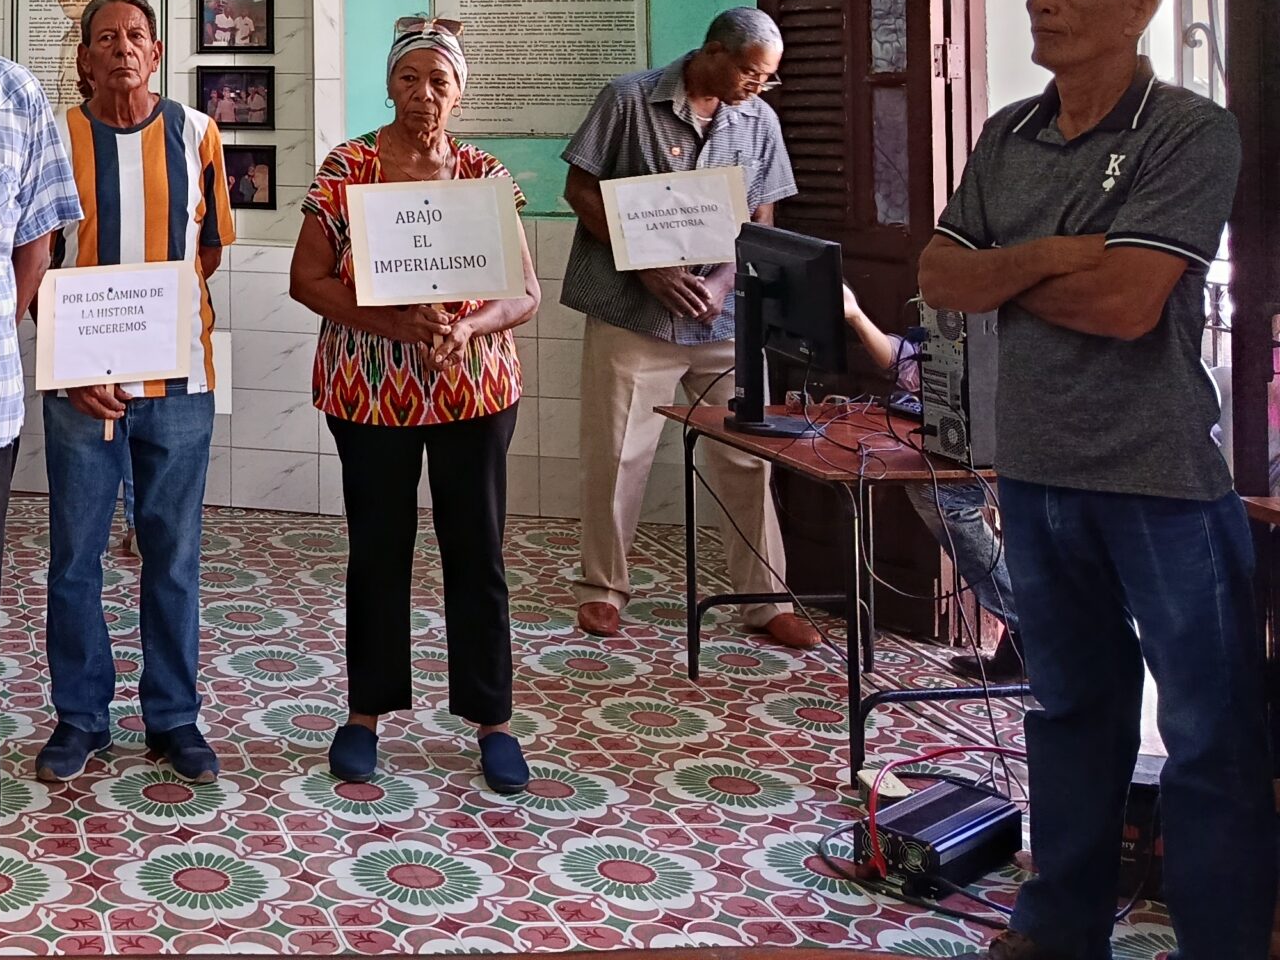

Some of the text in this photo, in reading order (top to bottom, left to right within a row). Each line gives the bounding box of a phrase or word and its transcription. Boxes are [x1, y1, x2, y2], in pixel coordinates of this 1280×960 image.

[1105, 153, 1126, 176] K
[395, 209, 443, 226] ABAJO
[627, 204, 719, 221] LA UNIDAD NOS DIO
[646, 218, 705, 231] LA VICTORIA
[413, 235, 432, 248] EL
[374, 254, 487, 274] IMPERIALISMO
[62, 287, 164, 304] POR LOS CAMINO DE
[81, 305, 145, 319] LA HISTORIA
[78, 321, 147, 336] VENCEREMOS
